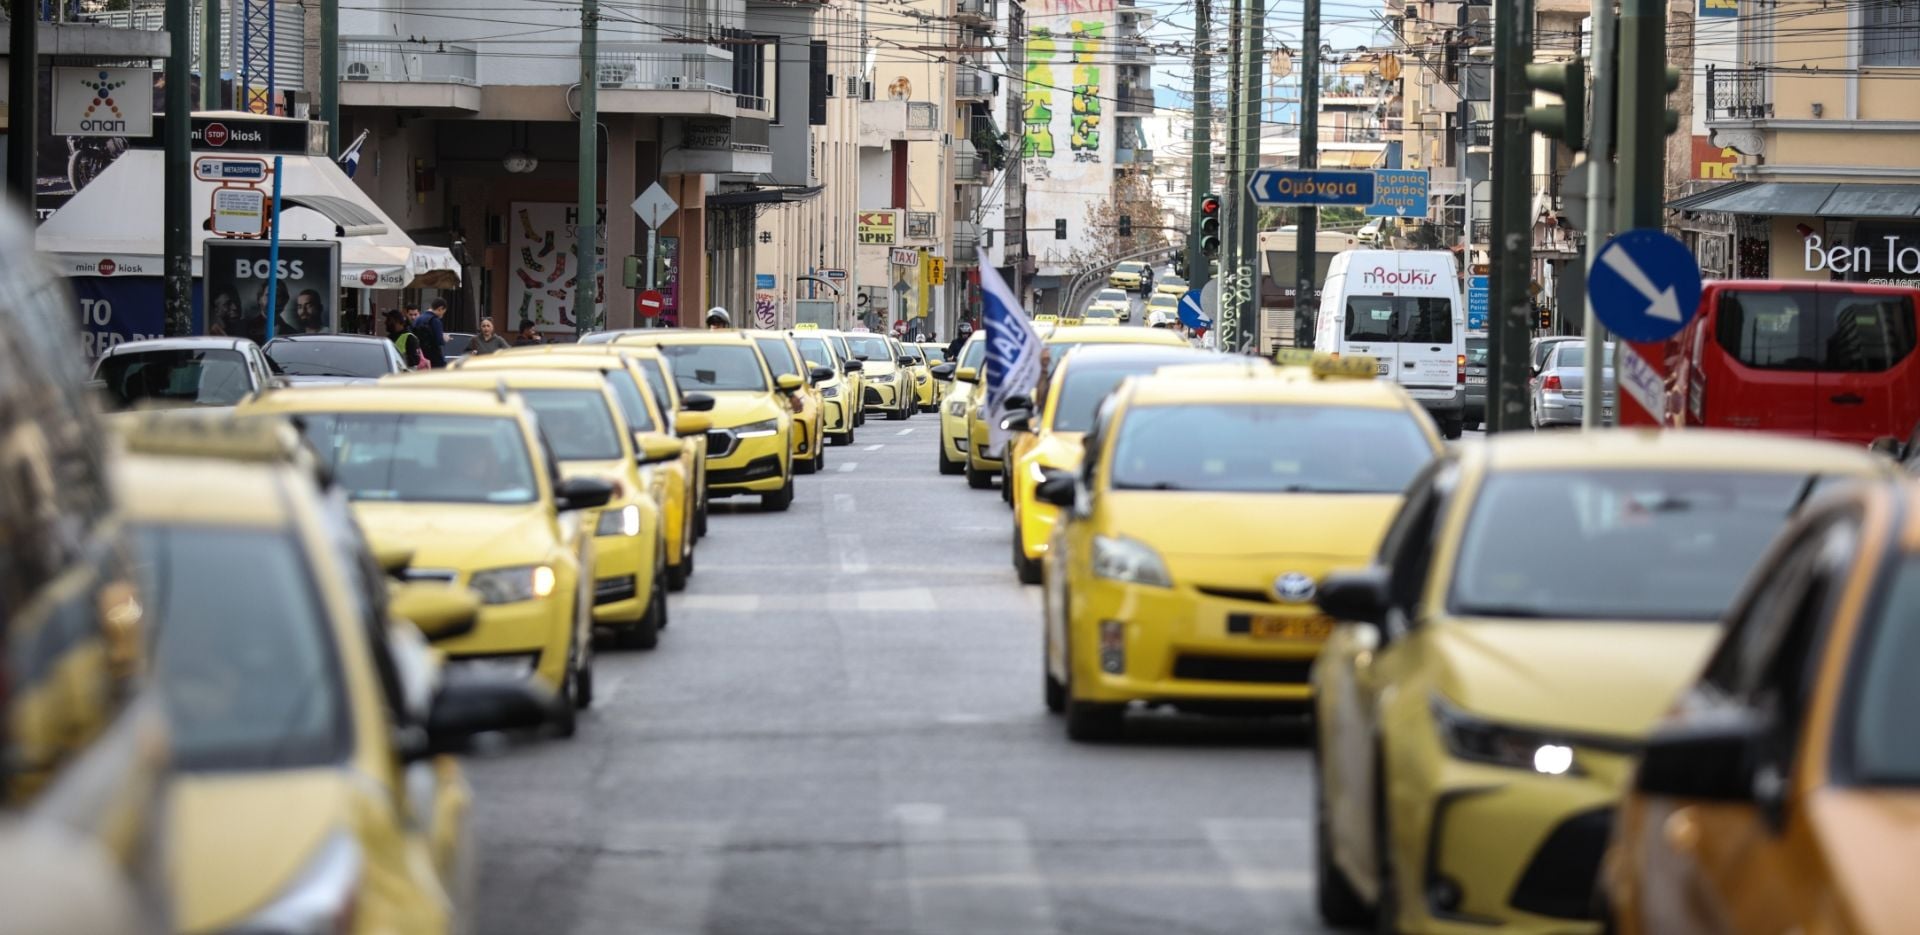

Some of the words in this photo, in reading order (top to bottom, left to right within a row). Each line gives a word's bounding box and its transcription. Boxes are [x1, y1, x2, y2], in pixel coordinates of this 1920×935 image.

[208, 130, 225, 138] STOP
[231, 130, 262, 142] kiosk
[1377, 173, 1425, 185] ειραιάς
[1278, 177, 1358, 198] Ομόνοια
[894, 250, 917, 265] TAXI
[1804, 235, 1871, 273] Ben
[1882, 235, 1920, 274] Ta
[76, 262, 96, 271] mini
[118, 263, 143, 273] kiosk
[235, 258, 304, 280] BOSS
[381, 274, 404, 284] kiosk
[80, 298, 113, 326] TO
